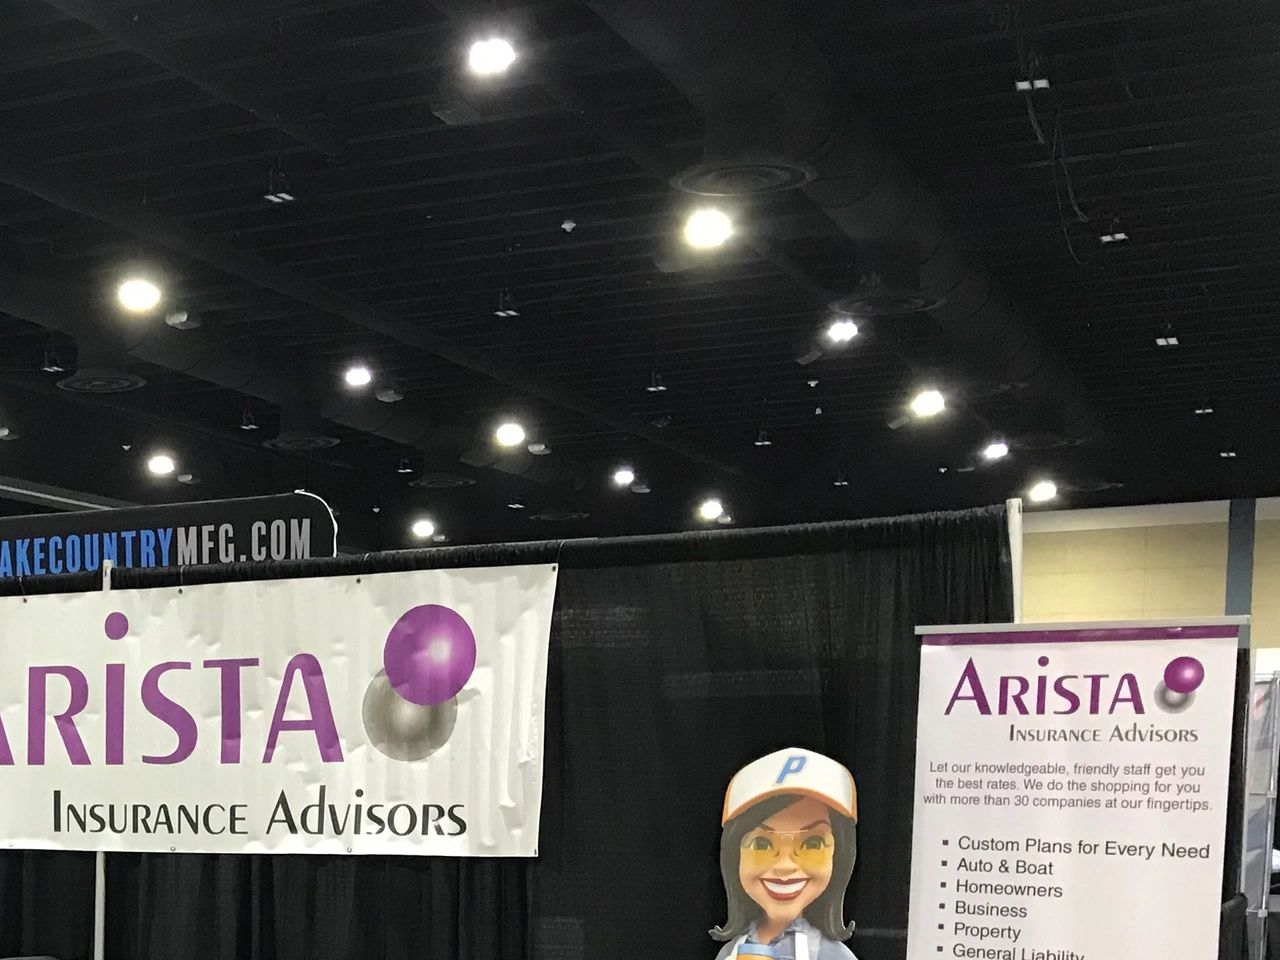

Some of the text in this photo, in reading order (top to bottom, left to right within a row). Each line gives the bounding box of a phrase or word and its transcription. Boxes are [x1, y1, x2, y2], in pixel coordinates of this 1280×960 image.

[775, 756, 807, 784] P
[930, 761, 1205, 779] Let our knowledgeable, friendly staff get you
[936, 777, 1200, 796] the best rates. We do the shopping for you
[923, 793, 1212, 813] with more than 30 companies at our fingertips.
[958, 835, 1210, 860] Custom Plans for Every Need
[957, 857, 1053, 875] Auto & Boat
[956, 879, 1063, 898] Homeowners
[955, 900, 1027, 918] Business
[954, 922, 1021, 943] Property
[953, 943, 1016, 960] General
